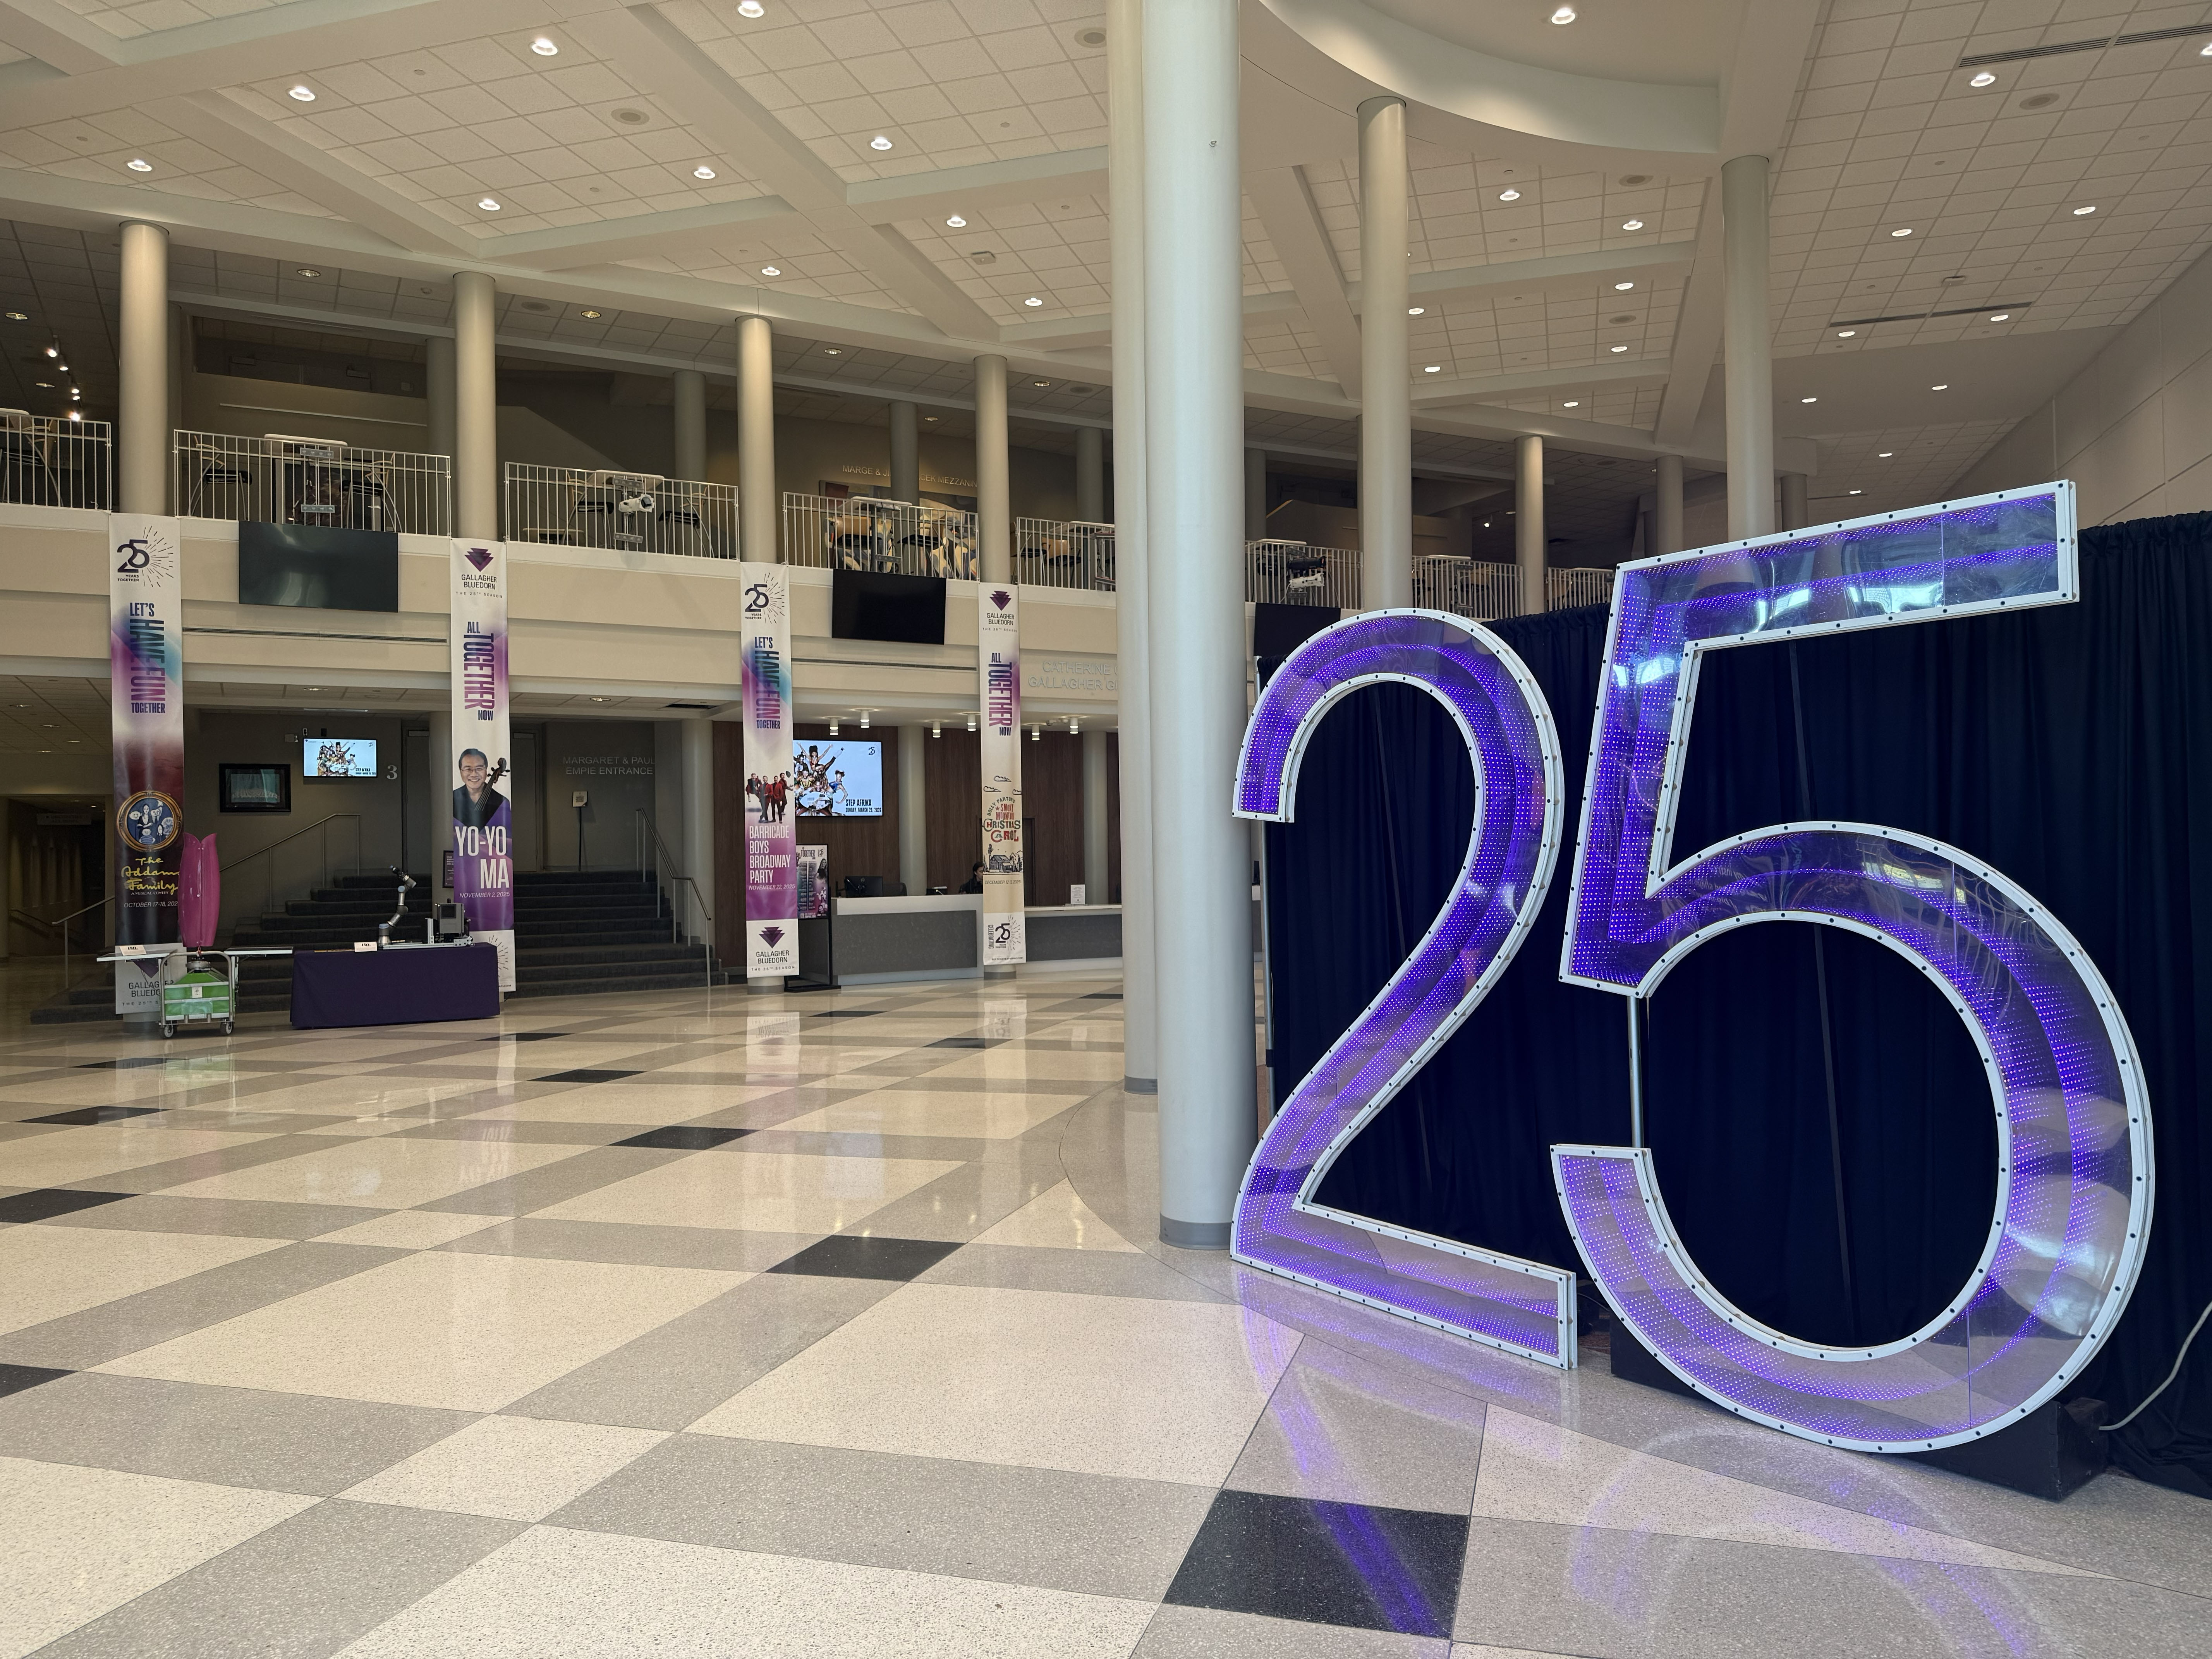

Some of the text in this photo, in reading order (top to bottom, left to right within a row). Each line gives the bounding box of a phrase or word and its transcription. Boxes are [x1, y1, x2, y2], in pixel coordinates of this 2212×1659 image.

[843, 465, 873, 475] MARGE
[919, 474, 936, 482] CEK
[938, 476, 977, 488] MEZZANIN
[117, 539, 150, 573] 25
[461, 574, 496, 583] GALLAGHER
[744, 584, 769, 612] 25
[130, 602, 155, 617] LET'S
[467, 622, 480, 634] ALL
[755, 637, 773, 649] LET'S
[130, 619, 165, 701] HAVE FUN
[991, 653, 1002, 663] ALL
[464, 633, 495, 710] TOGETHER
[1042, 661, 1111, 675] CATHERINE
[755, 651, 780, 719] HAVE FUN
[1028, 676, 1103, 690] GALLAGHER
[988, 662, 1012, 726] TOGETHER
[131, 702, 165, 713] TOGETHER
[478, 710, 493, 721] NOW
[756, 720, 780, 729] TOGETHER
[1000, 727, 1011, 736] NOW
[868, 747, 875, 755] 25
[563, 756, 655, 764] MARGARET & PAUL
[387, 765, 397, 780] 3
[987, 802, 996, 816] DOLLY
[1001, 804, 1013, 812] SMOKY
[996, 812, 1014, 821] MOUNTAIN
[749, 825, 789, 839] BARRICADE
[982, 818, 1021, 832] CHRISTMAS
[455, 826, 507, 857] YO-YO
[991, 830, 1019, 843] CAROL
[750, 840, 769, 854] BOYS
[136, 856, 163, 866] The
[750, 855, 791, 869] BROADWAY
[480, 859, 510, 889] MA
[750, 870, 773, 883] PARTY
[126, 878, 178, 895] Family
[995, 923, 1011, 943] 25
[1231, 479, 2155, 1453] 25
[129, 980, 173, 989] GALLAGER
